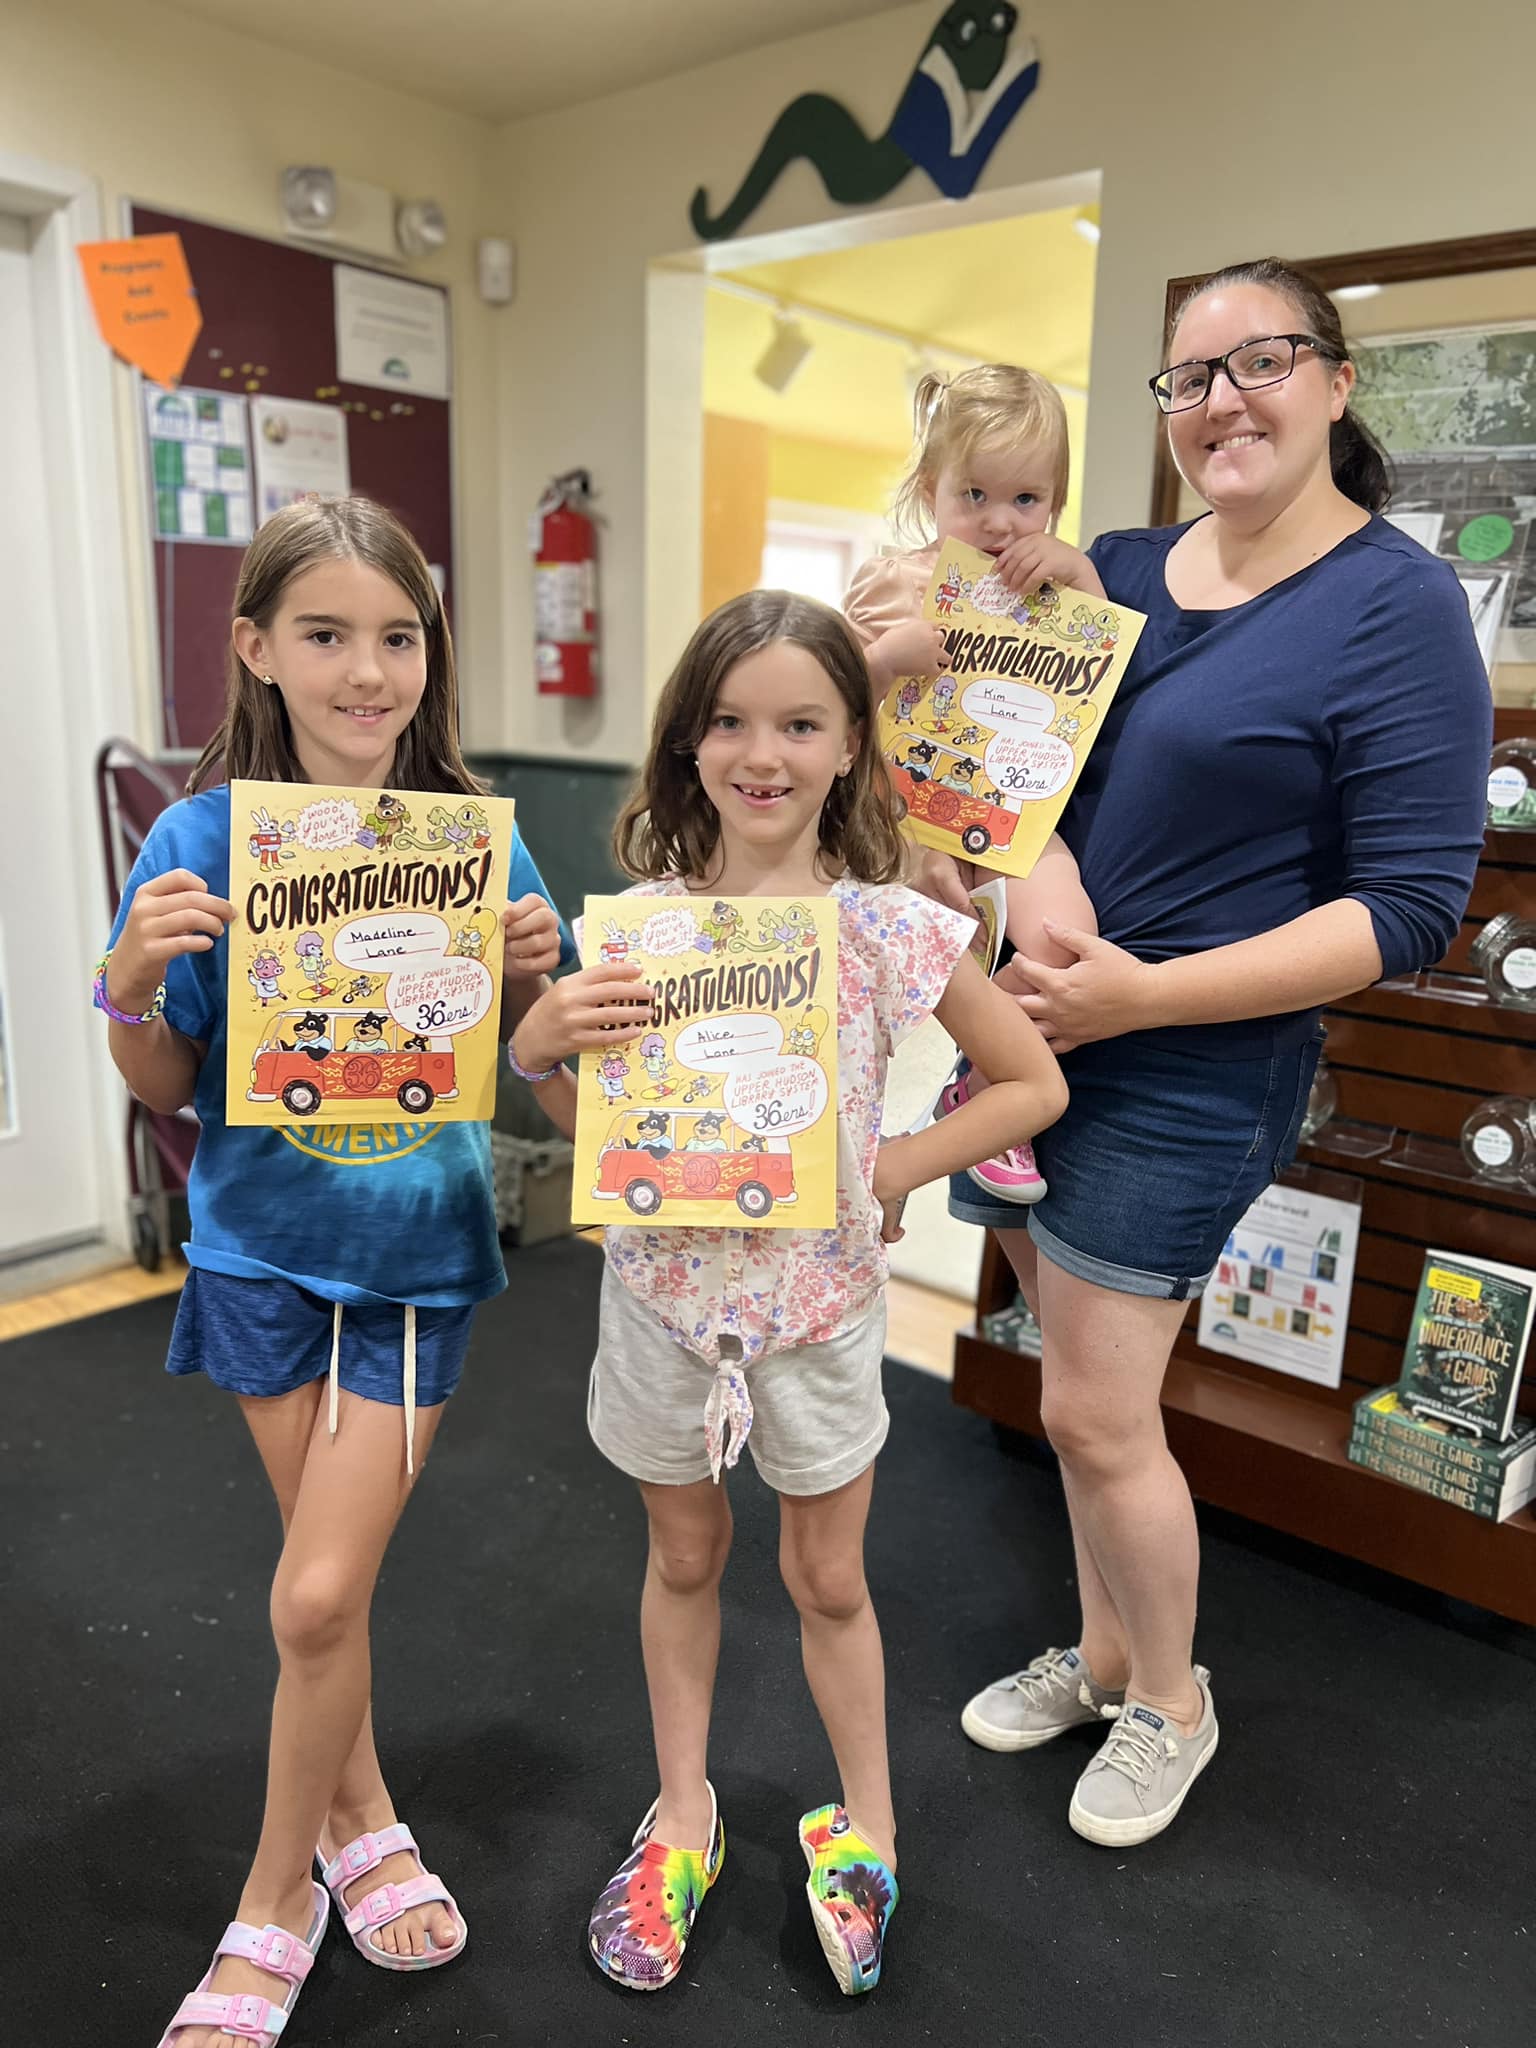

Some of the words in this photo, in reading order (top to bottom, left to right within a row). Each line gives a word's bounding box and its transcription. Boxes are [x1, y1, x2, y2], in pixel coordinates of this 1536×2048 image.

[937, 628, 1114, 705] NGRATULATIONS!
[984, 687, 1006, 702] Kim
[991, 704, 1018, 720] Lane
[989, 754, 1029, 767] LIBRARY
[1031, 759, 1068, 769] SYSTEM
[995, 745, 1028, 757] UPPER
[1030, 750, 1069, 761] HUDSON
[312, 830, 338, 844] done
[341, 817, 355, 836] it!
[246, 850, 492, 934] CONGRATULATIONS!
[350, 927, 417, 943] Madeline
[366, 946, 407, 959] Lane
[397, 980, 434, 998] UPPER
[440, 971, 482, 987] HUDSON
[399, 973, 416, 985] HAS
[421, 967, 451, 981] JOINED
[456, 962, 472, 974] THE
[393, 991, 439, 1009] LIBRARY
[444, 979, 485, 998] SYSTEM
[598, 947, 820, 1030] GRATULATIONS!
[697, 1031, 734, 1043] Alice
[704, 1048, 737, 1059] Lane
[347, 1058, 379, 1089] 36
[734, 1079, 770, 1097] UPPER
[775, 1069, 816, 1087] HUDSON
[735, 1073, 752, 1085] HAS
[758, 1066, 786, 1080] JOINED
[791, 1061, 806, 1072] THE
[731, 1089, 776, 1109] LIBRARY
[781, 1078, 819, 1097] SYSTEM
[1430, 1289, 1455, 1317] THE
[1418, 1318, 1514, 1368] INHERITANCE
[1452, 1359, 1498, 1395] GAMES
[1449, 1445, 1484, 1473] GAMES
[1444, 1464, 1480, 1493] GAMES
[1440, 1482, 1477, 1511] GAMES
